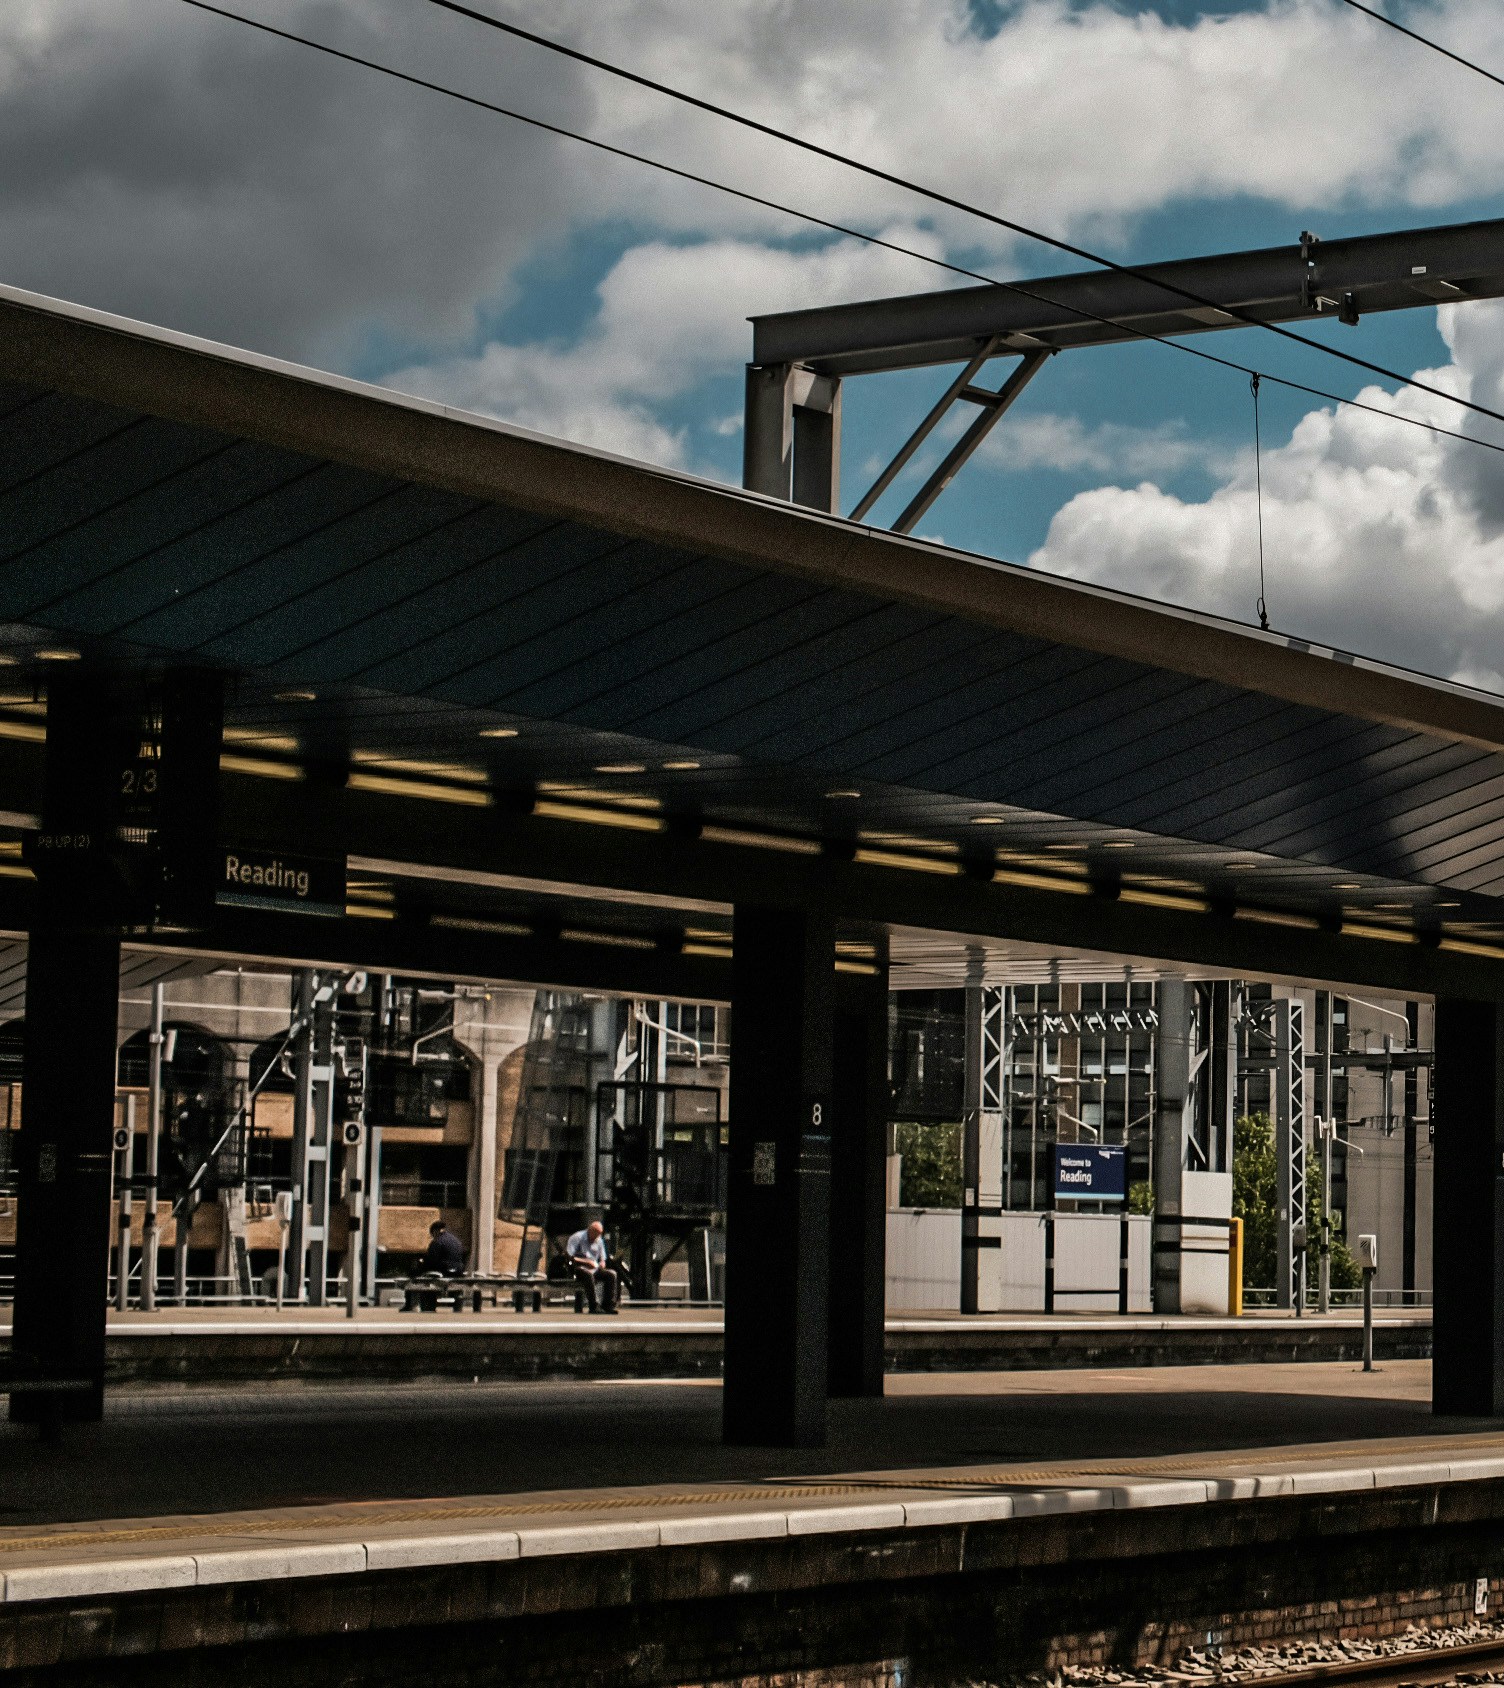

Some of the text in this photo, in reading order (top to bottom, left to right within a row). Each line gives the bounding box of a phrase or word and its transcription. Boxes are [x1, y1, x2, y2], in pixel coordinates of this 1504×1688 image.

[121, 769, 157, 797] 2/3
[226, 854, 309, 897] Reading
[812, 1103, 822, 1126] 8
[1085, 1159, 1092, 1167] to
[1060, 1169, 1092, 1186] Reading
